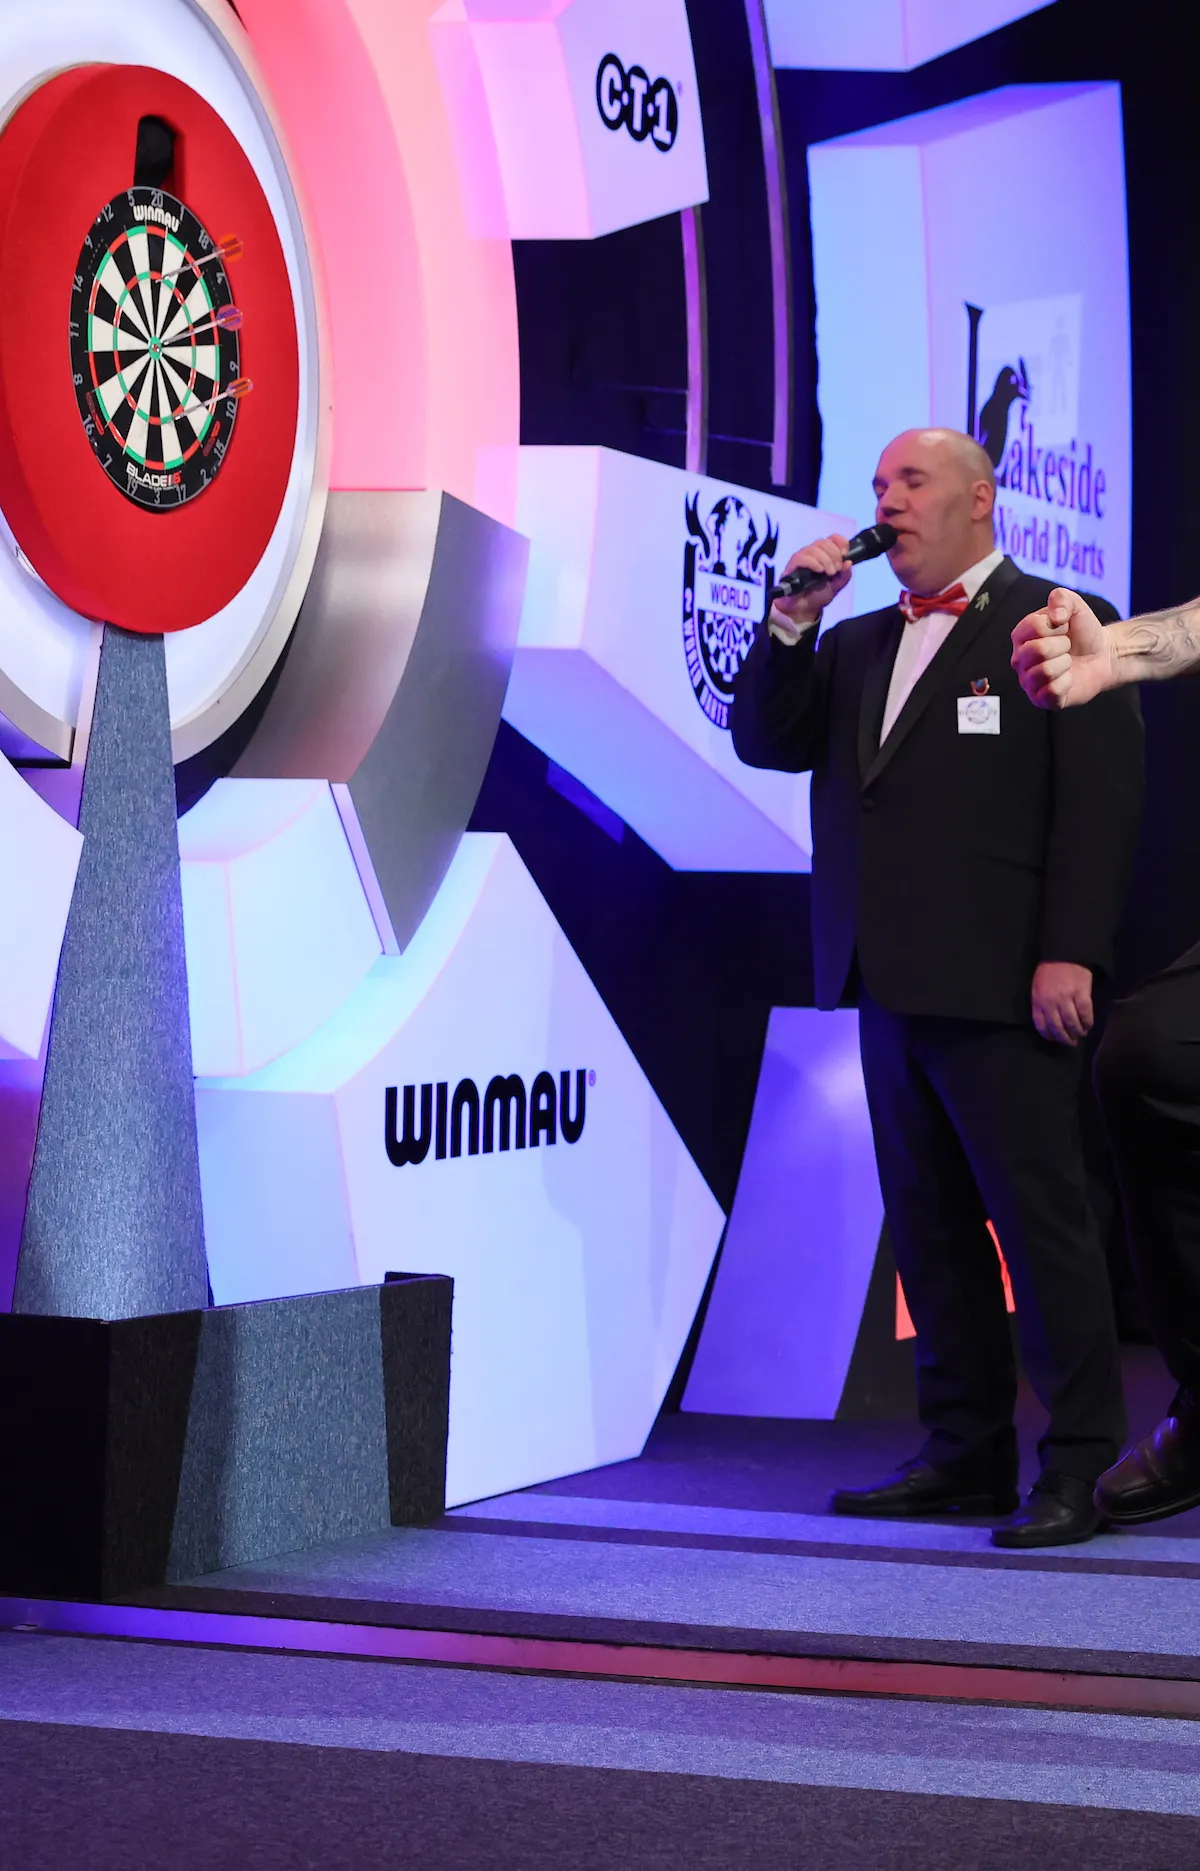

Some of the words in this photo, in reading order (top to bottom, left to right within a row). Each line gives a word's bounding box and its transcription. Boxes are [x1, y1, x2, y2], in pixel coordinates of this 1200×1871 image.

[128, 189, 135, 206] 5
[151, 190, 163, 208] 20
[101, 203, 114, 222] 12
[133, 205, 179, 233] WINMAU
[198, 229, 210, 250] 18
[73, 274, 84, 293] 14
[73, 373, 83, 386] 8
[83, 414, 95, 436] 16
[1057, 523, 1105, 580] Darts
[711, 582, 750, 611] WORLD
[385, 1069, 586, 1167] WINMAU
